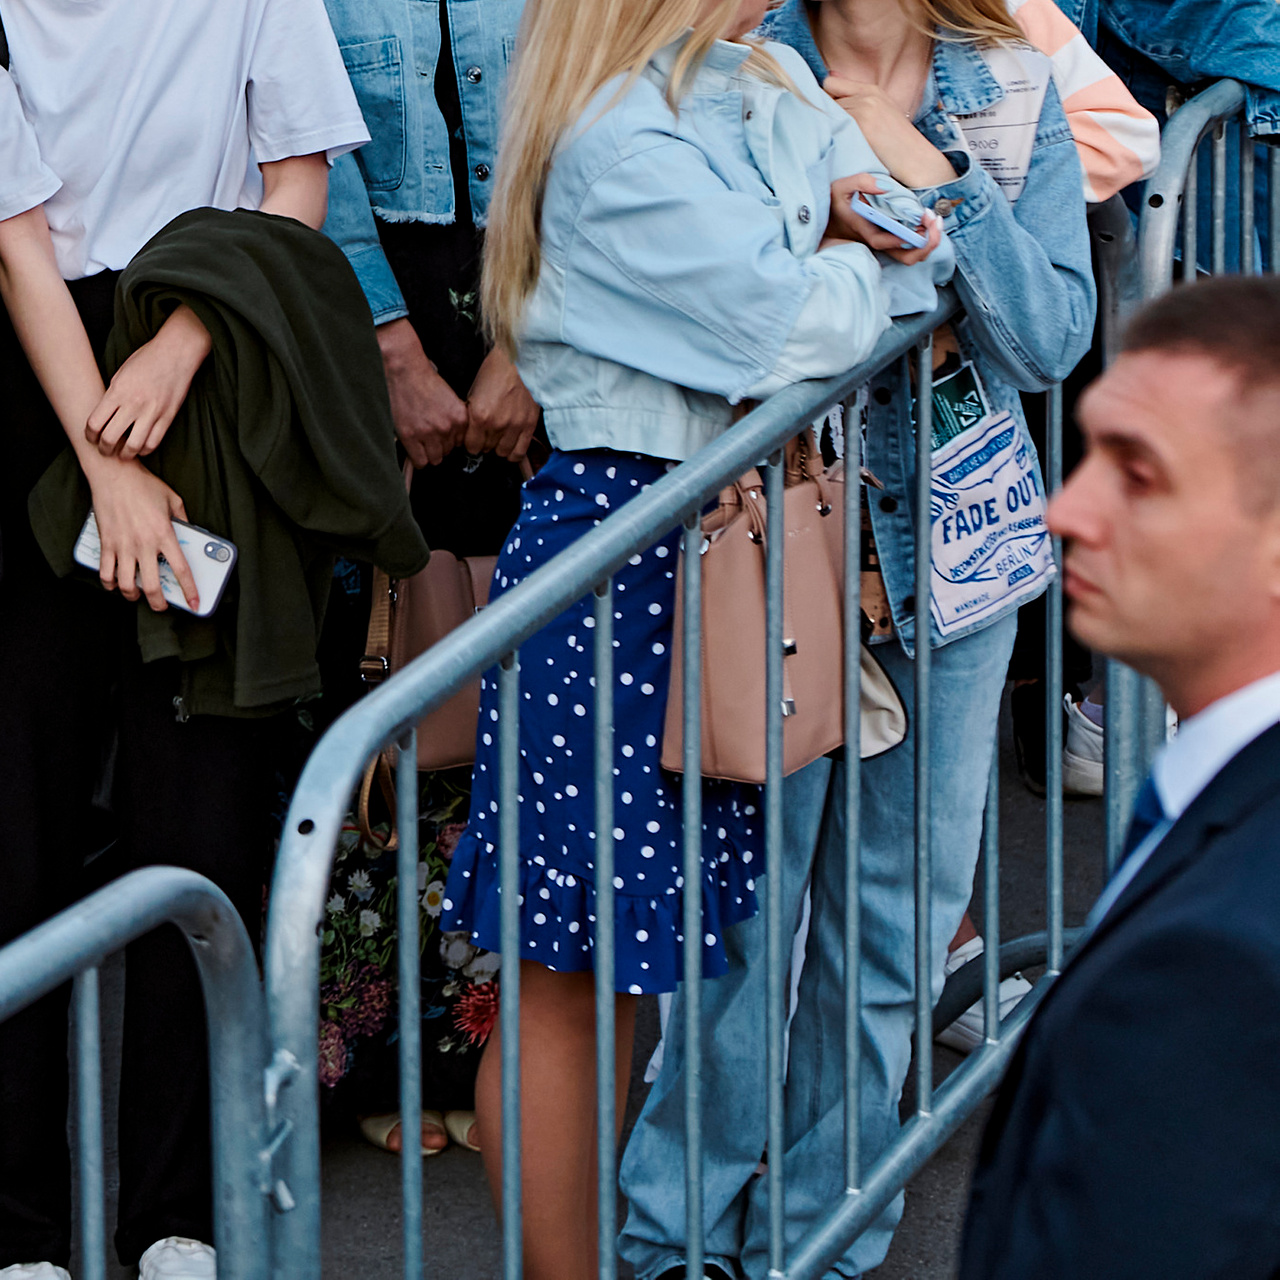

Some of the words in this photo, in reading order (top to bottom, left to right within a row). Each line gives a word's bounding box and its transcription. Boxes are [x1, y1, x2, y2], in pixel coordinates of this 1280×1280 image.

[942, 496, 1000, 545] FADE
[1006, 469, 1040, 513] OUT
[995, 544, 1033, 576] BERLIN
